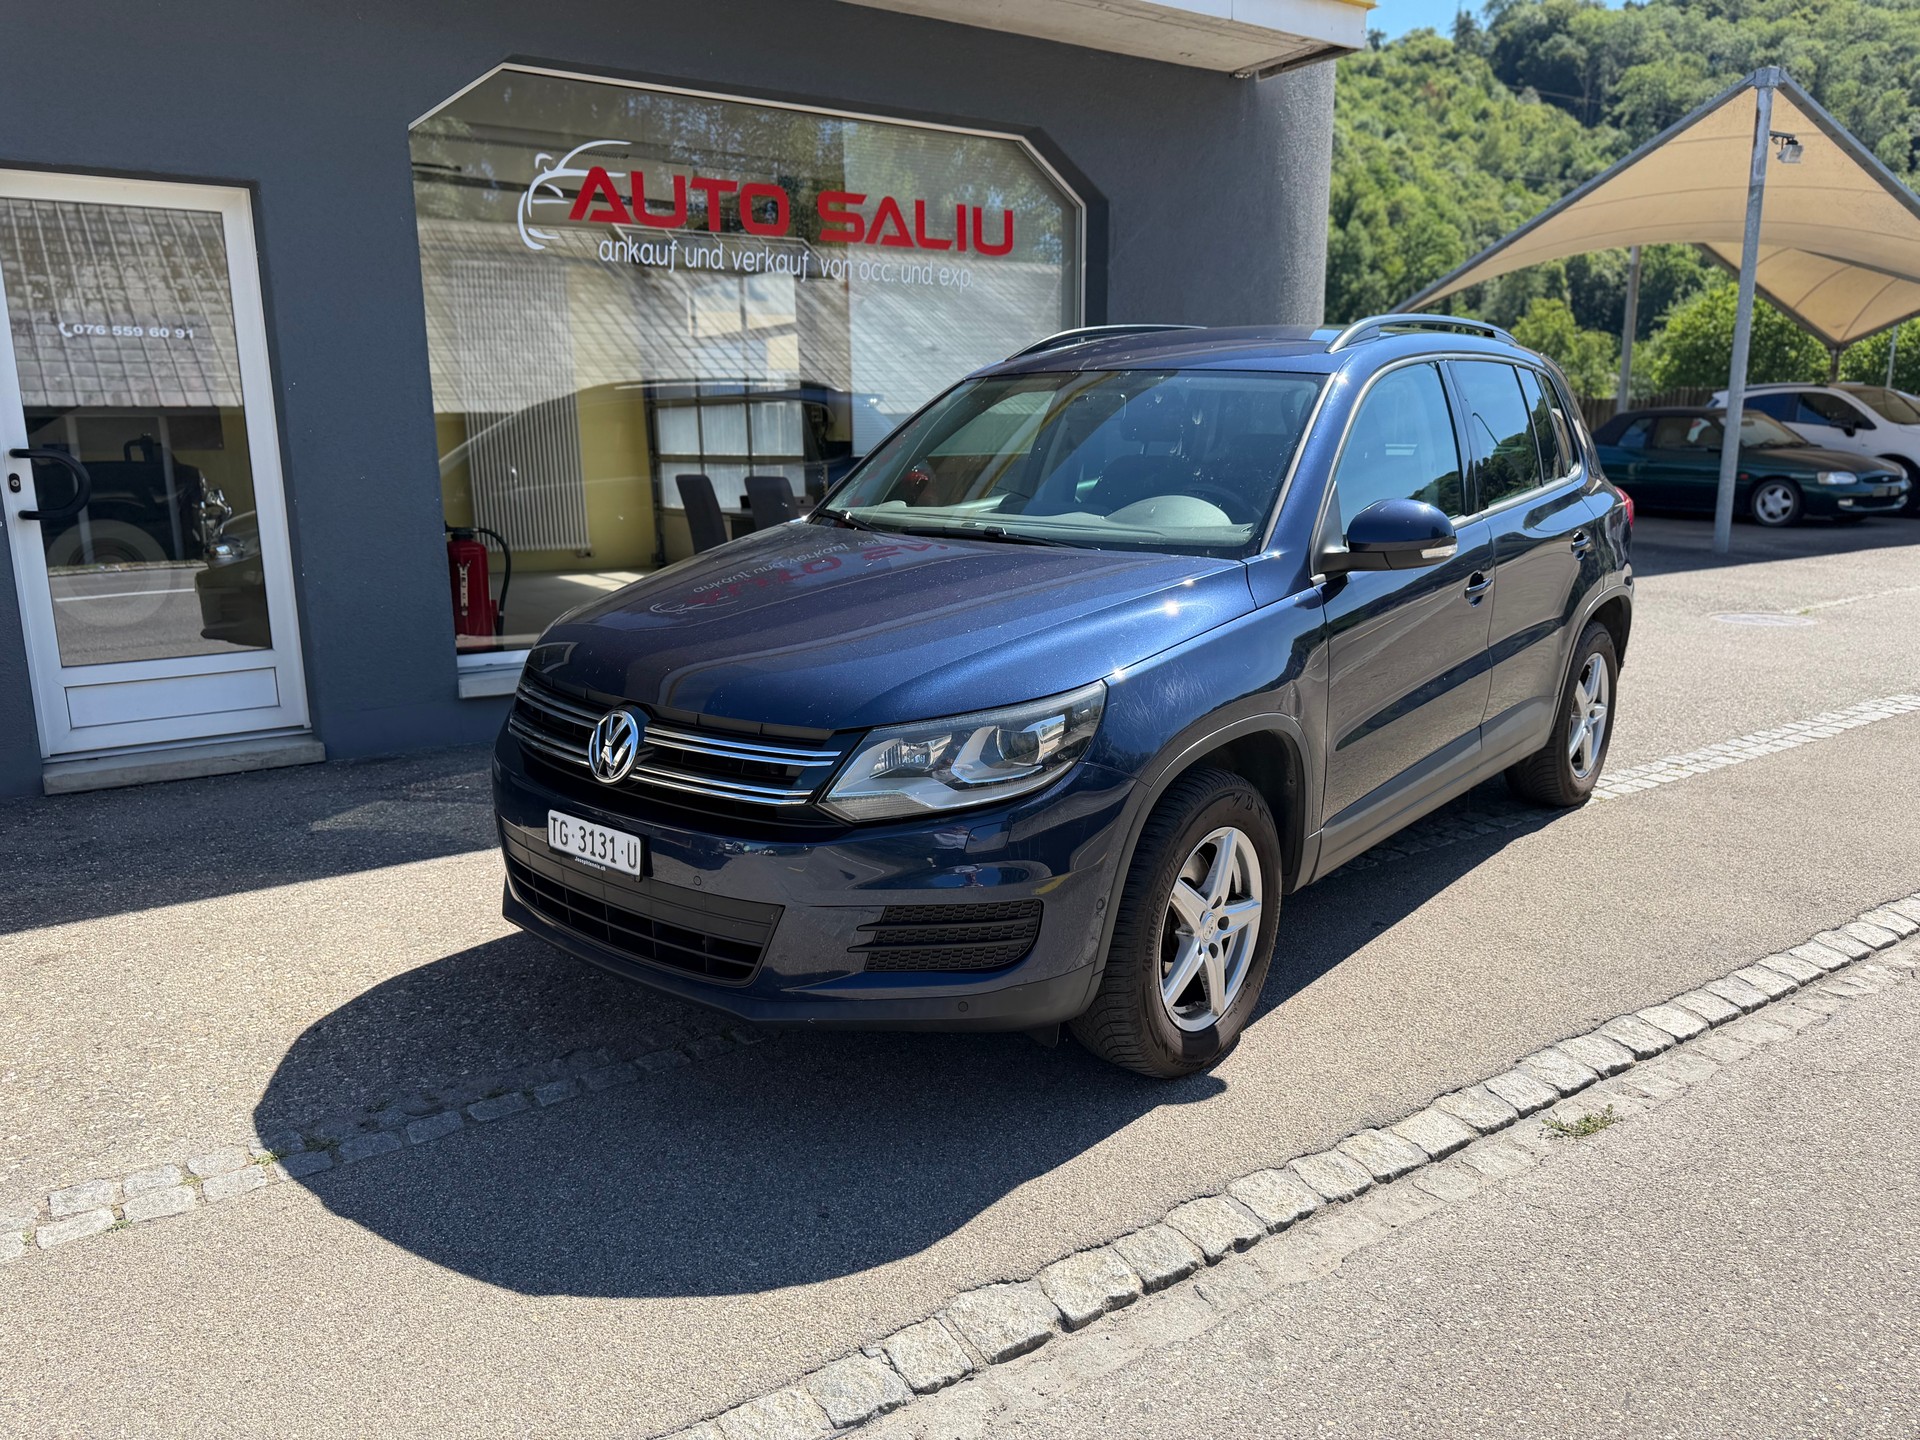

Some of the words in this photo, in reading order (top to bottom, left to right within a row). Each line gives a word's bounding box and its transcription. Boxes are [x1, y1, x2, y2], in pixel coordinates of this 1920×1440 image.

[568, 166, 790, 237] AUTO
[817, 190, 1014, 257] SALIU
[599, 235, 678, 273] ankauf
[684, 243, 725, 270] und
[731, 246, 809, 283] verkauf
[820, 258, 853, 279] von
[858, 261, 895, 282] occ.
[901, 261, 934, 286] und
[938, 266, 974, 293] exp.
[73, 323, 106, 336] 076
[112, 325, 143, 337] 559
[149, 327, 169, 338] 60
[175, 328, 193, 339] 91
[588, 709, 639, 784] VW
[550, 816, 568, 847] TG
[578, 826, 617, 865] 3131
[627, 840, 637, 869] U
